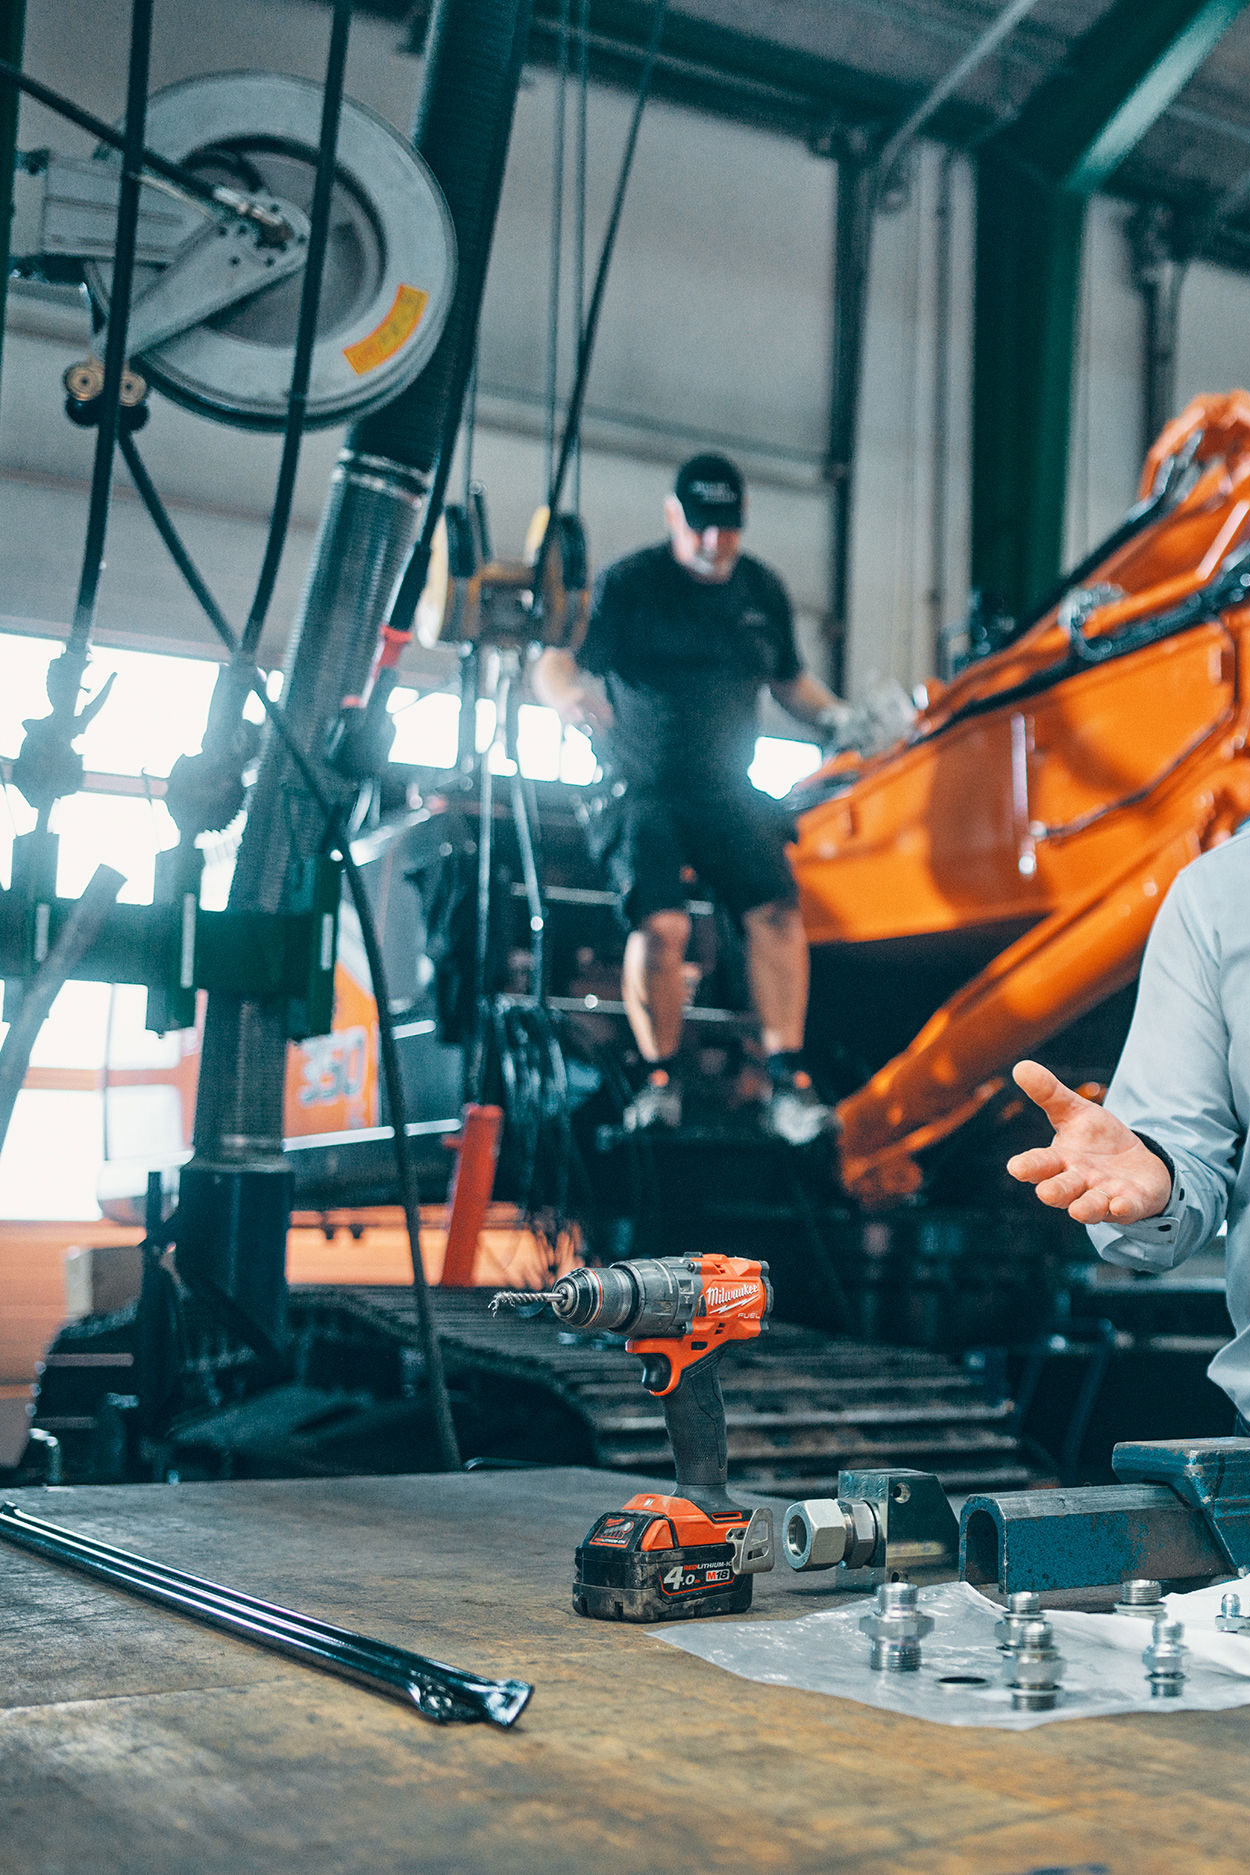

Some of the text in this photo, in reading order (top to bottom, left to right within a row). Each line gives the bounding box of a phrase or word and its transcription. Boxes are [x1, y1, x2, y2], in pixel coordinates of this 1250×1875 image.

[705, 1283, 760, 1307] Milwaukee
[663, 1565, 730, 1590] 4.0 M18
